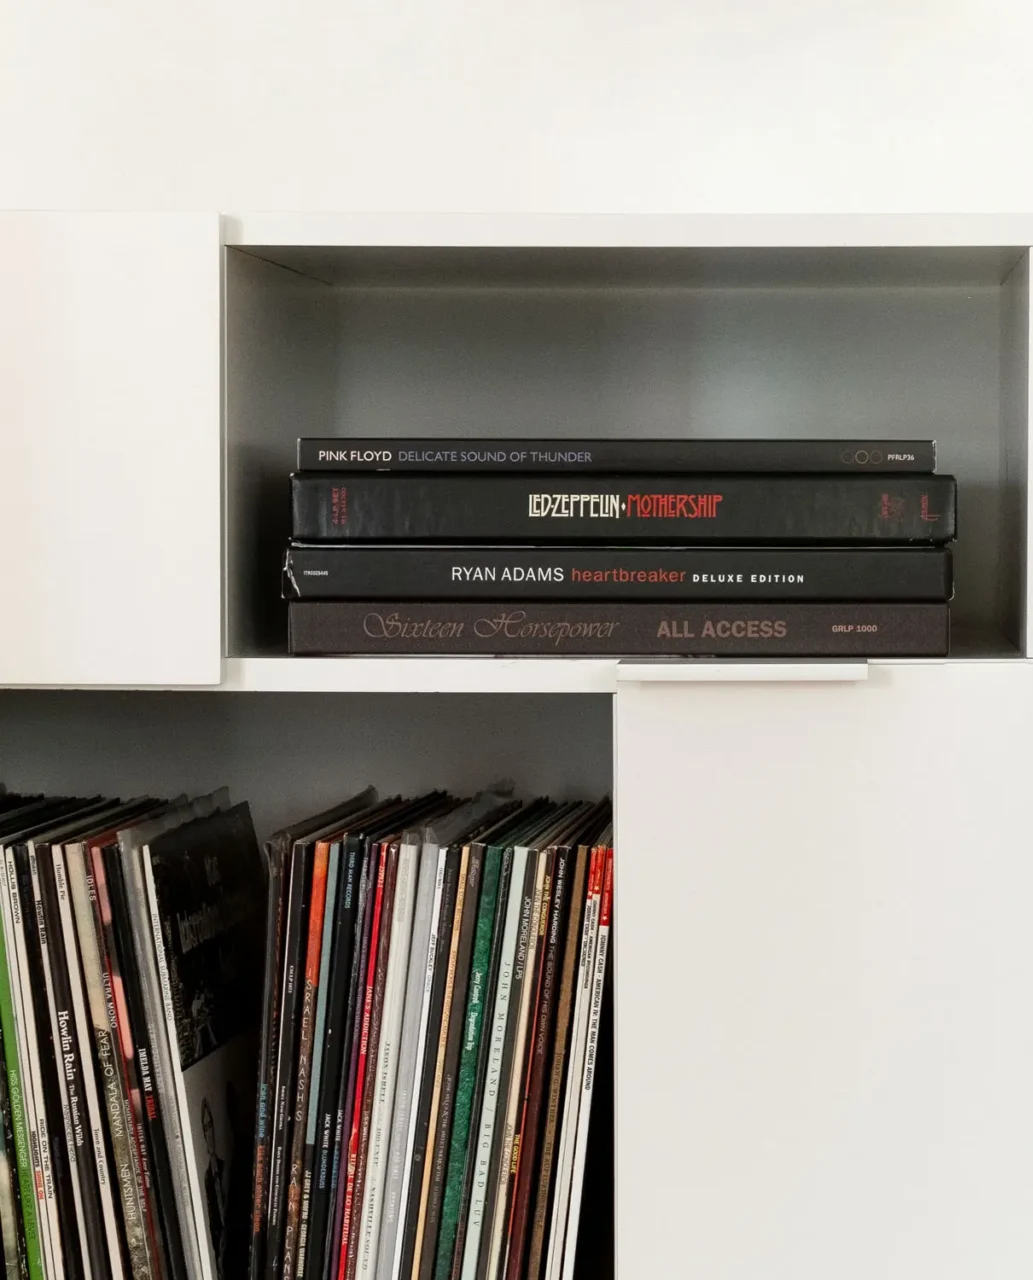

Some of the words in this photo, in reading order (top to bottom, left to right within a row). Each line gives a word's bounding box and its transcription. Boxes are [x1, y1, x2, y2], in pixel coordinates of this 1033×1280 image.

[318, 451, 347, 462] PINK
[350, 451, 392, 462] FLOYD
[398, 452, 458, 462] DELICATE
[460, 452, 506, 463] SOUND
[510, 452, 527, 463] OF
[530, 452, 592, 463] THUNDER
[626, 494, 723, 518] MOTHERSHIP
[452, 566, 496, 581] RYAN
[502, 566, 564, 582] ADAMS
[572, 568, 686, 582] heartbreaker
[692, 574, 744, 583] DELUXE
[750, 574, 804, 583] EDITION
[363, 612, 465, 640] Sixteen
[473, 610, 619, 645] Horsepower
[657, 620, 694, 638] ALL
[702, 620, 787, 638] ACCESS
[832, 624, 854, 632] GRLP
[856, 624, 878, 632] 1000
[55, 864, 65, 889] Humble
[557, 858, 565, 877] JOHN
[58, 891, 66, 900] Pie
[86, 875, 96, 900] IDLES
[554, 880, 563, 908] WESLEY
[522, 897, 531, 916] JOHN
[550, 910, 559, 943] HARDING
[517, 919, 529, 960] MORELAND
[598, 935, 606, 956] JOHNNY
[596, 958, 604, 974] CASH
[102, 973, 113, 998] ULTRA
[500, 961, 511, 1001] JOHN
[593, 979, 602, 1008] AMERICAN
[106, 1003, 117, 1028] MONO
[57, 1011, 73, 1051] Howlin
[589, 1031, 597, 1043] MAN
[63, 1054, 77, 1080] Rain
[488, 1013, 505, 1097] MORELAND
[587, 1045, 595, 1065] COMES
[9, 1070, 18, 1085] HISS
[585, 1067, 593, 1090] AROUND
[11, 1087, 22, 1120] GOLDEN
[70, 1096, 81, 1124] Russian
[15, 1122, 27, 1167] MESSENGER
[74, 1125, 84, 1146] Wilds
[482, 1124, 491, 1148] BIG
[477, 1161, 487, 1188] BAD
[472, 1200, 482, 1227] LUV
